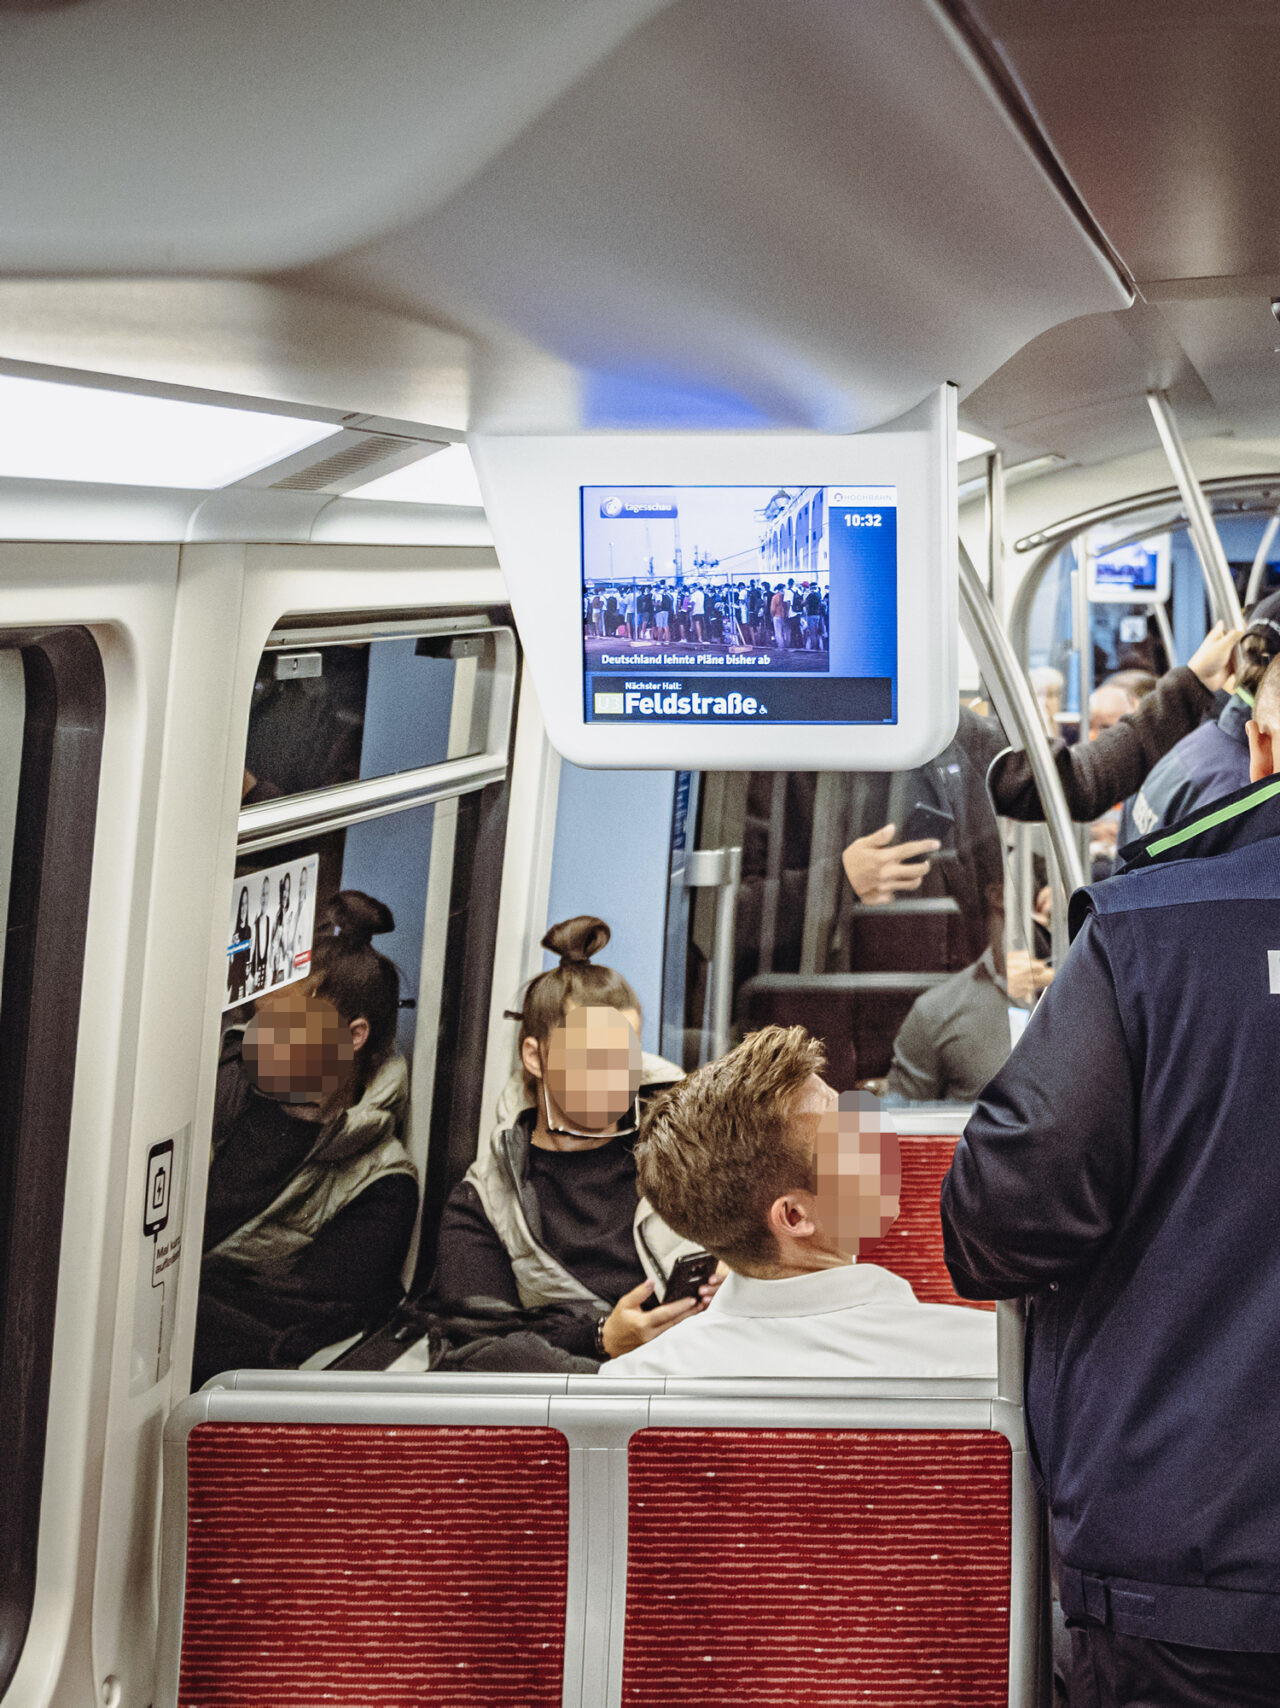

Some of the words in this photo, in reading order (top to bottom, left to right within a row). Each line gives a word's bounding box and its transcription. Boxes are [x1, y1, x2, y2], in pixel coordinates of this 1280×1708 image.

[624, 502, 672, 513] tagesschau
[844, 513, 882, 527] 10:32
[601, 654, 662, 665] Deutschland
[663, 654, 695, 665] lehnte
[696, 654, 724, 665] Pläne
[725, 654, 756, 665] bisher
[757, 654, 771, 665] ab
[625, 681, 661, 690] Nächster
[662, 681, 682, 690] Halt:
[625, 692, 757, 715] Feldstraße
